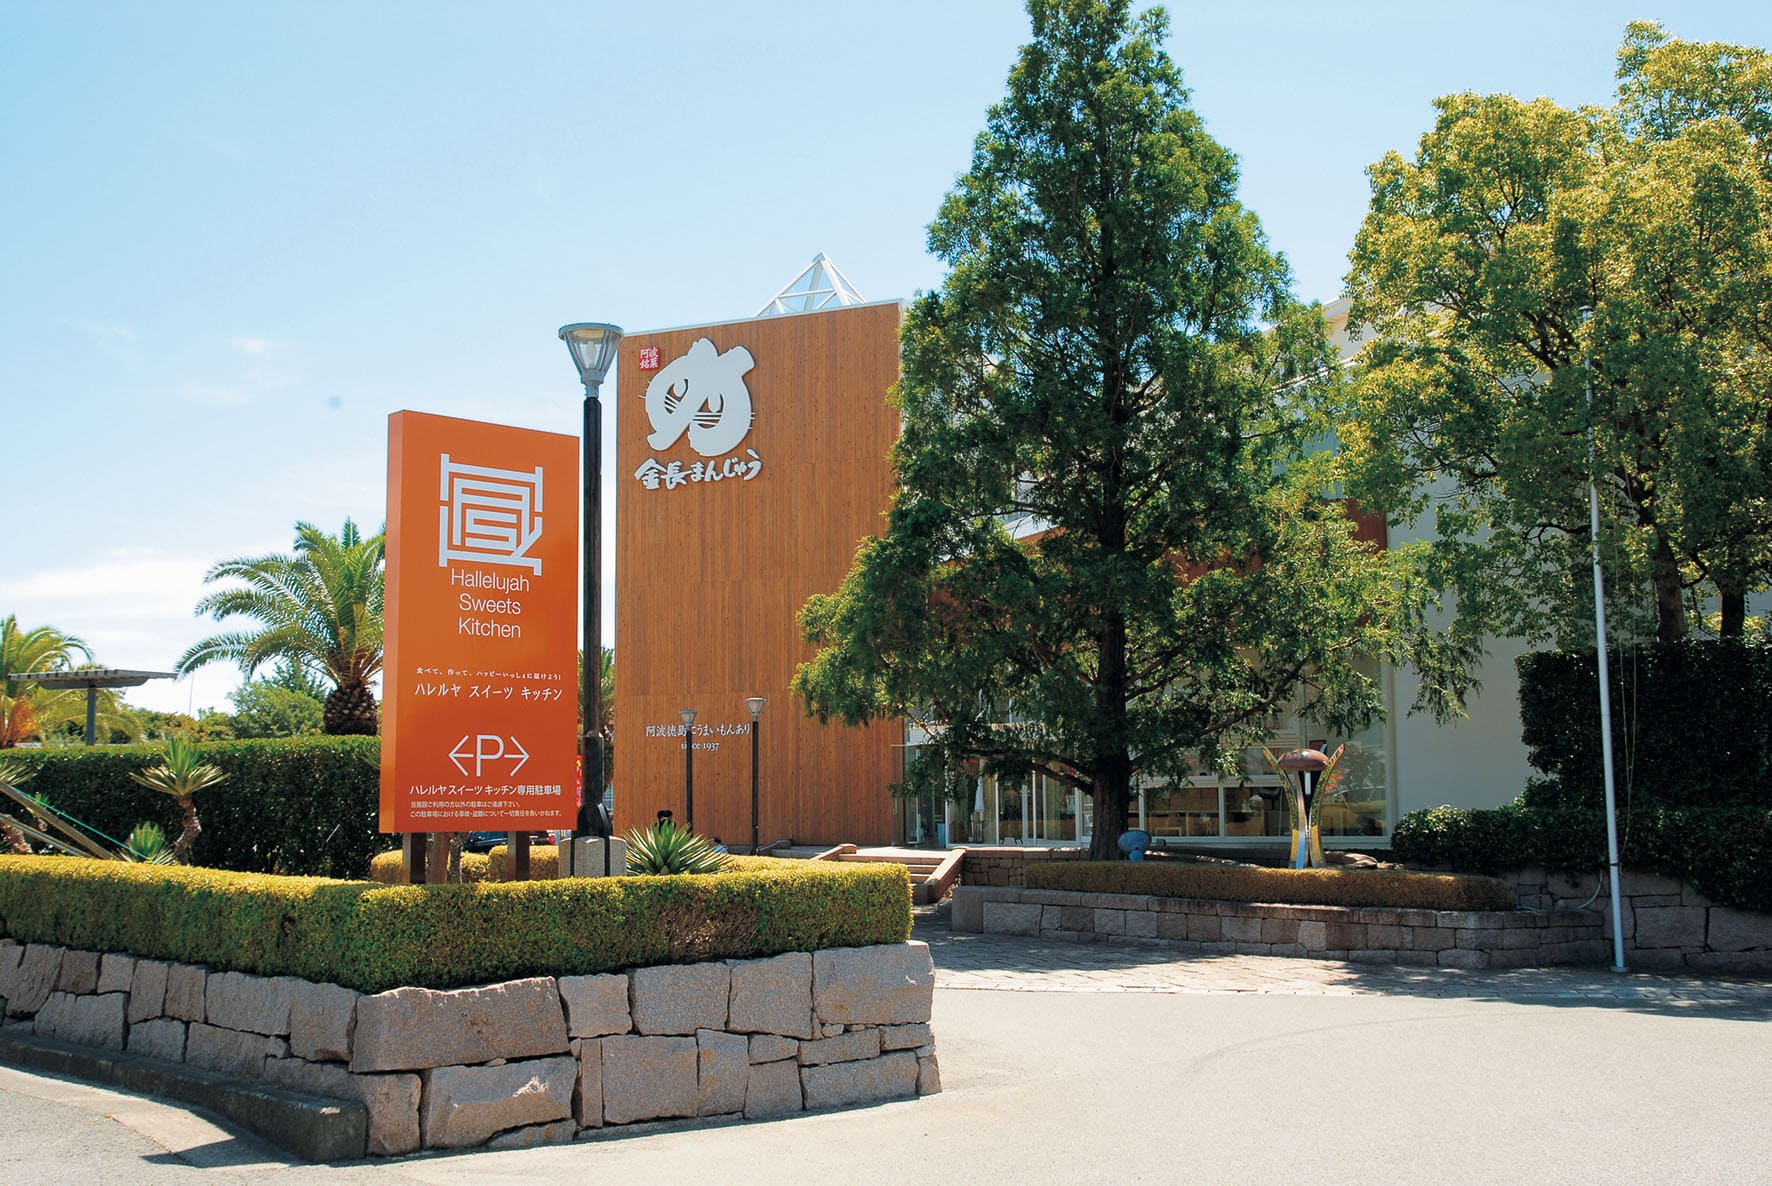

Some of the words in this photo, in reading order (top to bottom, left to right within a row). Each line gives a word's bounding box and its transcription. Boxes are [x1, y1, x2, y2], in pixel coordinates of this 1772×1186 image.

[634, 448, 763, 490] 金長まんじゅう
[451, 568, 530, 594] Hallelujah
[459, 593, 521, 615] Sweets
[458, 616, 521, 638] Kitchen
[415, 683, 461, 697] ハレルヤ
[469, 685, 513, 700] スイーツ
[521, 686, 563, 701] キッチン
[476, 734, 504, 777] P
[681, 741, 700, 750] sice
[703, 742, 720, 752] 1937
